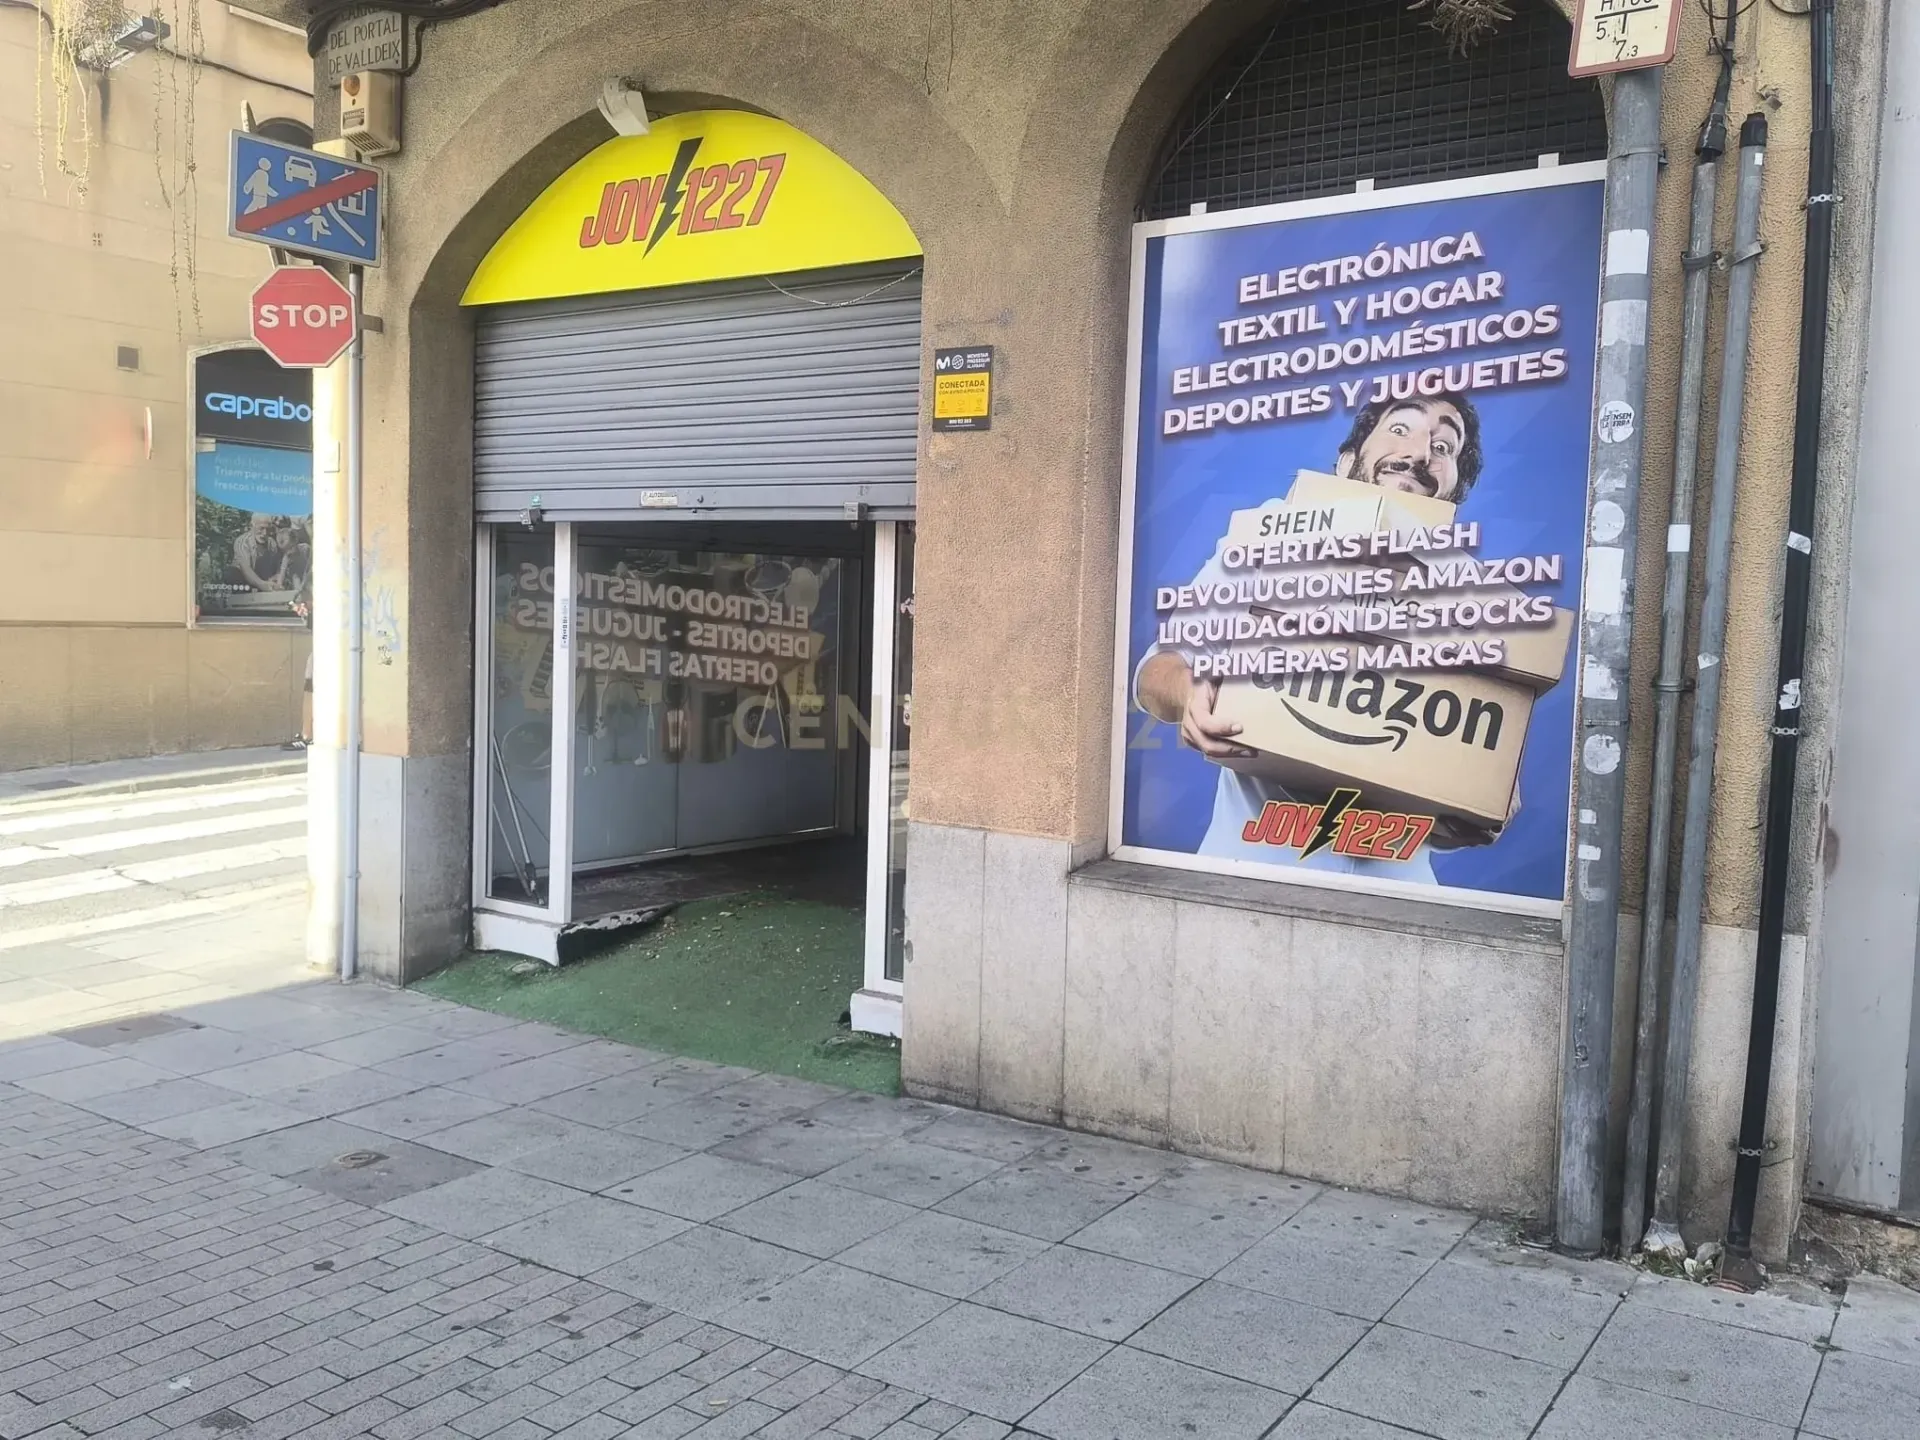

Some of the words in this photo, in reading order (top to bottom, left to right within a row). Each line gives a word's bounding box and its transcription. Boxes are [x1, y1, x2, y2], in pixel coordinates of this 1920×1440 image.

[331, 29, 350, 50] DEL
[354, 15, 399, 43] PORTAL
[329, 56, 342, 75] DE
[345, 39, 400, 70] VALLDEIX
[1239, 231, 1484, 303] ELECTRÓNICA
[258, 304, 348, 328] STOP
[1219, 304, 1326, 346] TEXTIL
[1334, 298, 1359, 326] Y
[1366, 271, 1505, 321] HOGAR
[1172, 305, 1560, 395] ELECTRODOMÉSTICOS
[939, 380, 985, 389] CONECTADA
[1163, 385, 1332, 436] DEPORTES
[1339, 381, 1365, 407] Y
[1370, 347, 1568, 404] JUGUETES
[205, 392, 312, 422] caprabo
[1258, 508, 1336, 537] SHEIN
[1222, 532, 1362, 569] OFERTAS
[1369, 521, 1480, 556] FLASH
[1156, 568, 1394, 610] DEVOLUCIONES
[1400, 554, 1562, 592] AMAZON
[1158, 606, 1357, 647] LIQUIDACIÓN
[1363, 605, 1408, 632] DE
[1415, 596, 1553, 629] STOCKS
[1193, 647, 1349, 678] PRIMERAS
[1357, 640, 1505, 669] MARCAS
